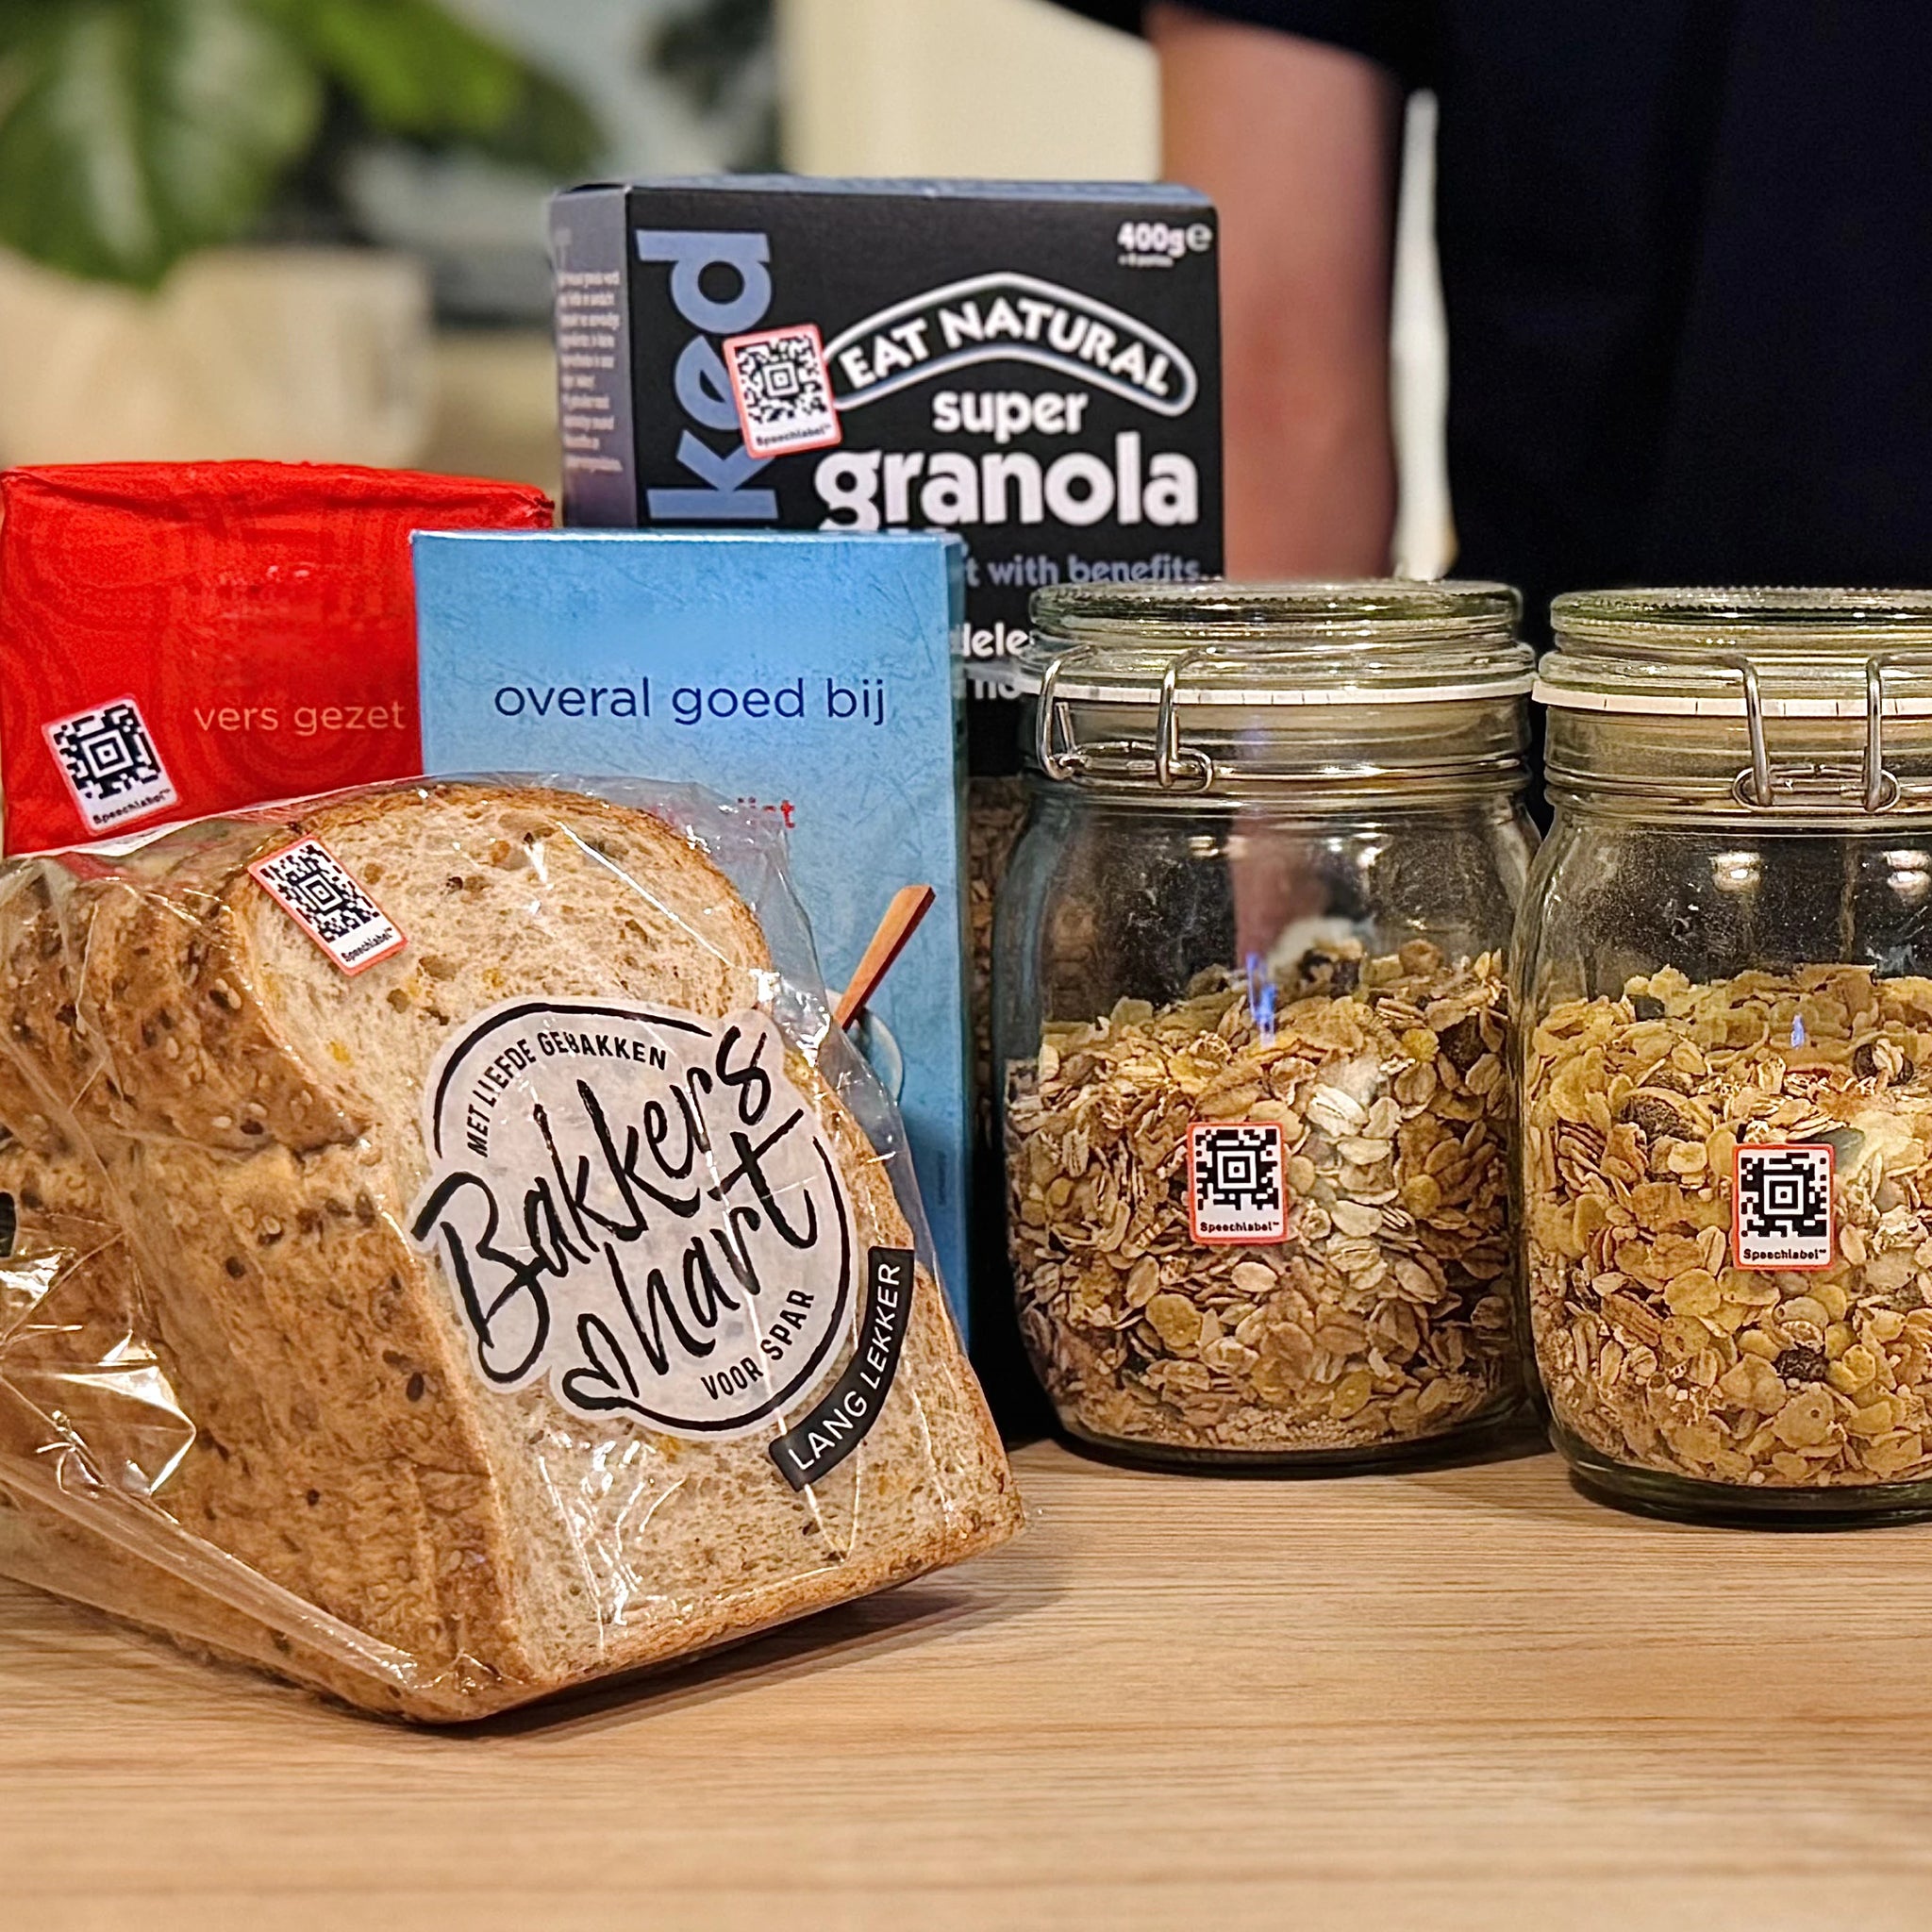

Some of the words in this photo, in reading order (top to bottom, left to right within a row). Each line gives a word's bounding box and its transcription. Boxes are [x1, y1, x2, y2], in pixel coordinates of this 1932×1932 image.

[1117, 223, 1187, 258] 400g
[838, 317, 929, 389] EAT
[938, 297, 1171, 397] NATURAL
[932, 390, 1089, 443] super
[815, 431, 1200, 530] granola
[987, 555, 1059, 587] with
[194, 707, 279, 732] vers
[293, 701, 408, 737] gezet
[494, 676, 651, 718] overal
[672, 676, 805, 725] goed
[826, 677, 885, 726] bij
[472, 1038, 537, 1108] LIEFDE
[536, 1030, 667, 1072] GEBAKKEN
[467, 1103, 491, 1158] MET
[411, 1024, 774, 1385] Bakkers
[602, 1108, 819, 1377] hart
[700, 1357, 765, 1400] VOOR
[760, 1290, 815, 1360] SPAR
[788, 1391, 868, 1471] LANG
[859, 1262, 902, 1391] LEKKER
